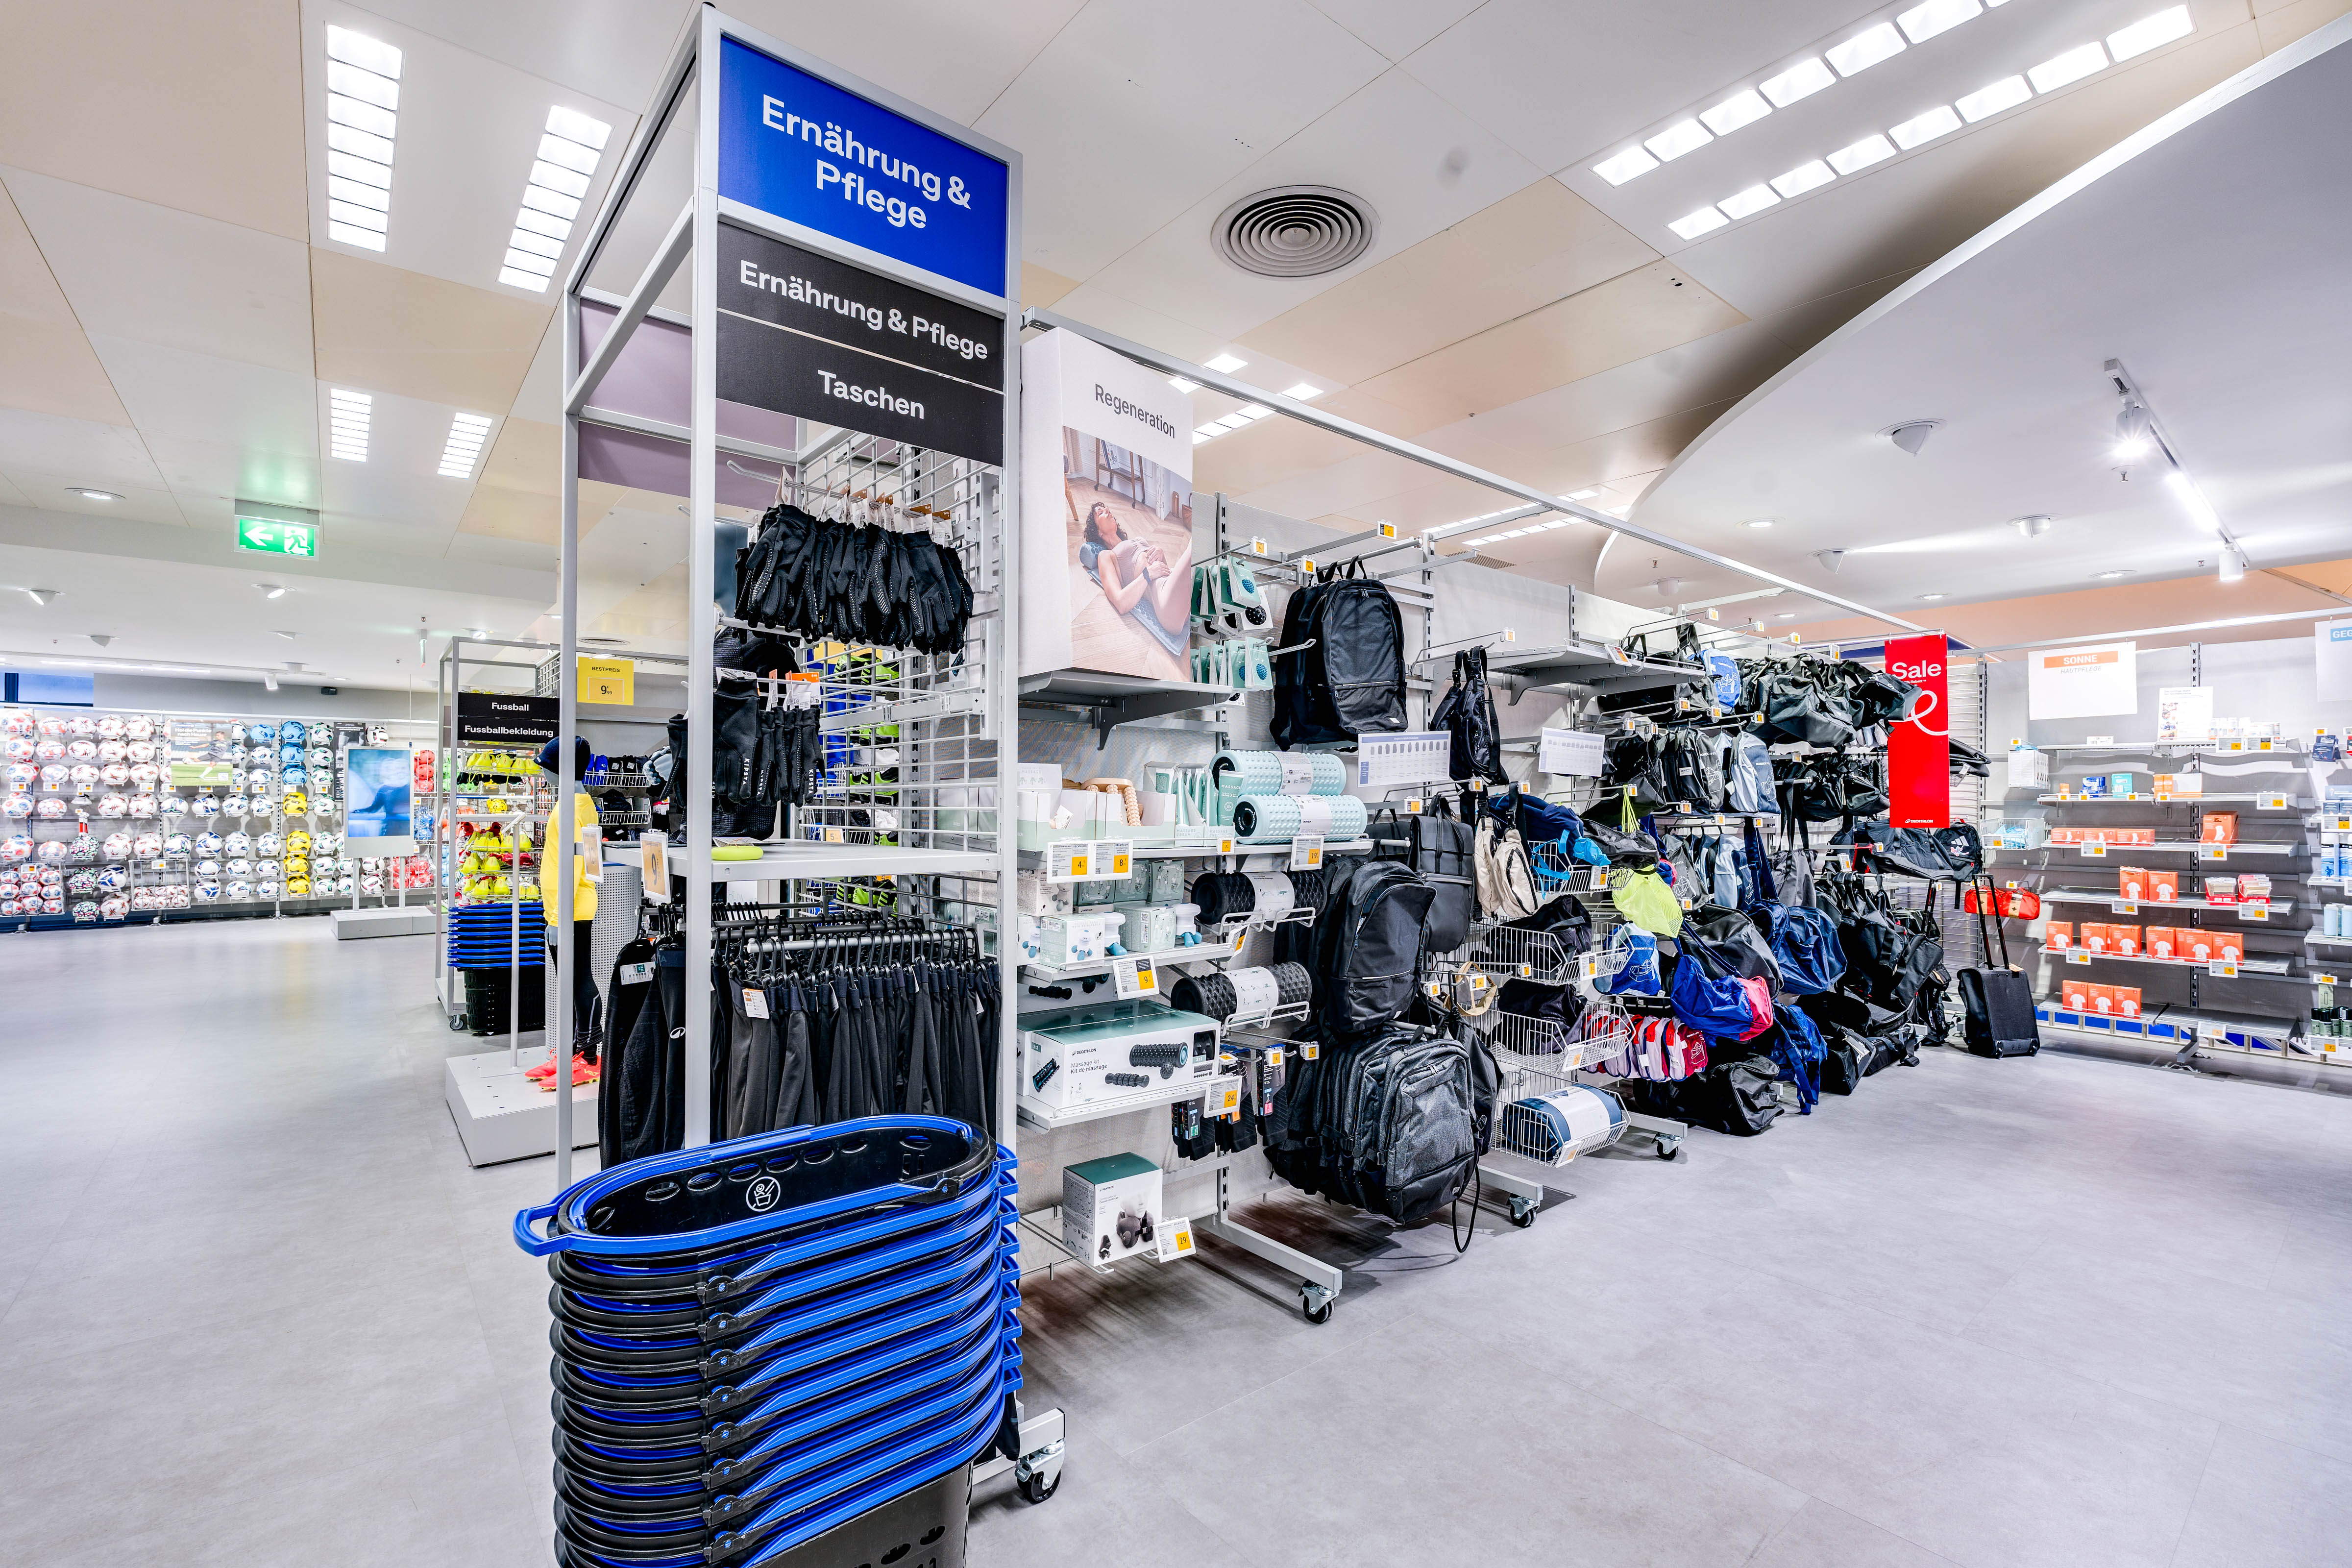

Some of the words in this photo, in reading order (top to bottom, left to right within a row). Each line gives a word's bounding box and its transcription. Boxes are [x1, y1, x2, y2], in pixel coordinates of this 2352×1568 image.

[762, 94, 941, 201] Ernährung
[948, 176, 972, 210] &
[816, 159, 927, 229] Pflege
[740, 259, 883, 330] Ernährung
[887, 309, 907, 335] &
[913, 316, 988, 360] Pflege
[818, 369, 925, 420] Taschen
[1095, 383, 1176, 438] Regeneration
[2063, 655, 2097, 664] SONNE
[1892, 660, 1941, 680] Sale
[2060, 666, 2102, 674] HAUTPFLEGE
[491, 702, 529, 712] Fussball
[465, 725, 554, 738] Fussballbekleidung
[742, 758, 750, 785] KIPSTA
[1071, 1059, 1093, 1069] Massage
[1085, 1064, 1108, 1073] massage
